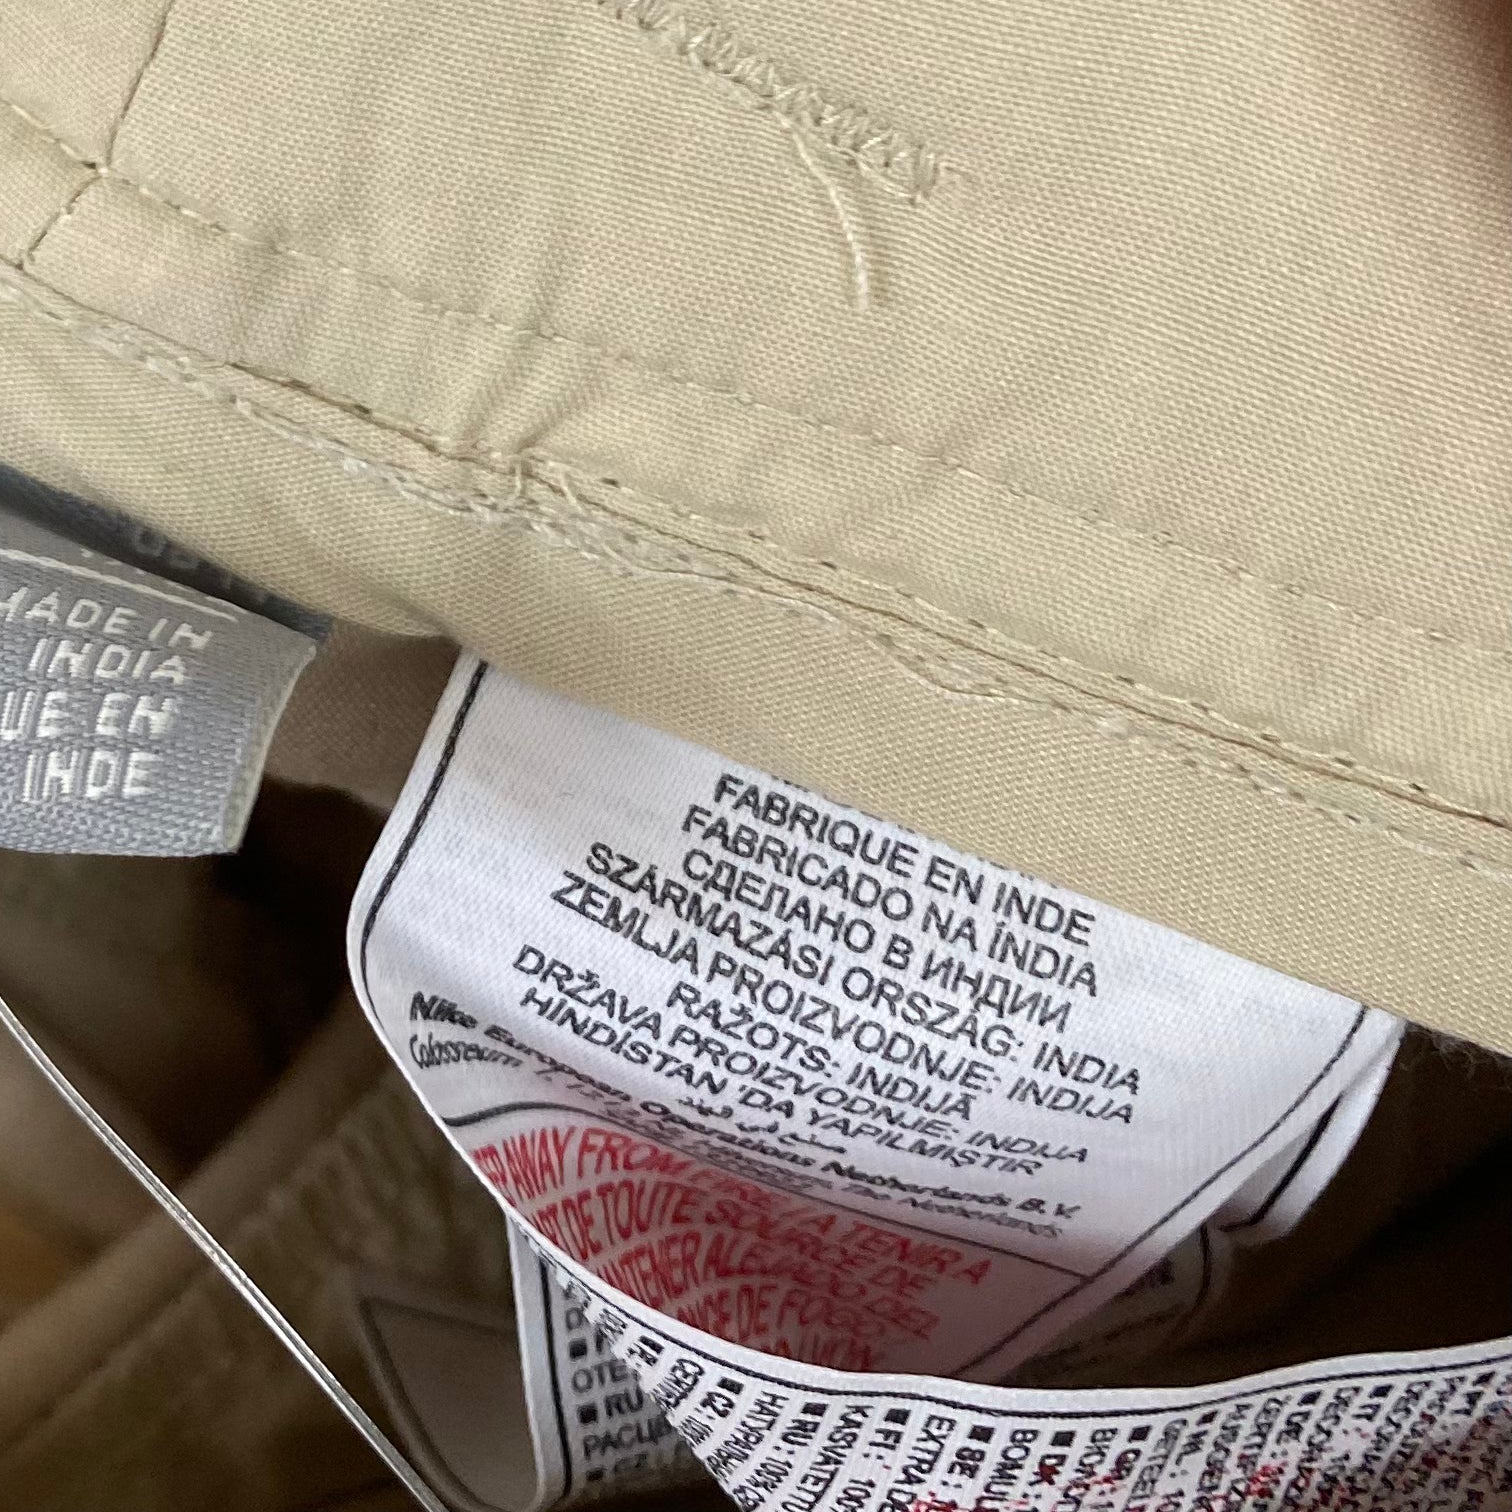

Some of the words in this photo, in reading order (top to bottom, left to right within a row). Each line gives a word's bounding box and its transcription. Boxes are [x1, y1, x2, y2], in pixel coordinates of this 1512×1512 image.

[28, 637, 191, 687] INDIA
[147, 616, 214, 651] IN
[22, 749, 163, 805] INDE
[95, 693, 180, 738] EN
[681, 804, 913, 922] FABRICADO
[921, 901, 977, 952] NA
[713, 773, 919, 878] FABRIQUE
[924, 856, 984, 905] EN
[992, 882, 1096, 946] INDE
[550, 870, 699, 976] ZEMLJA
[705, 950, 1001, 1094] PROIZVODNJE:
[1006, 1076, 1135, 1125] INDIJA
[585, 841, 835, 986] SZÁRMAZÁSI
[841, 965, 1026, 1062] ORSZÁG:
[1032, 1041, 1141, 1096] INDIA
[681, 848, 875, 954] СДЕЛАНО
[882, 934, 914, 970] В
[921, 951, 1072, 1034] ИНДИИ
[410, 990, 478, 1029] Nike
[511, 943, 662, 1041] DRŽAVA
[668, 1024, 960, 1141] PROIZVODNJE:
[965, 1130, 1088, 1163] INDIJA
[666, 980, 840, 1079] RAŽOTS:
